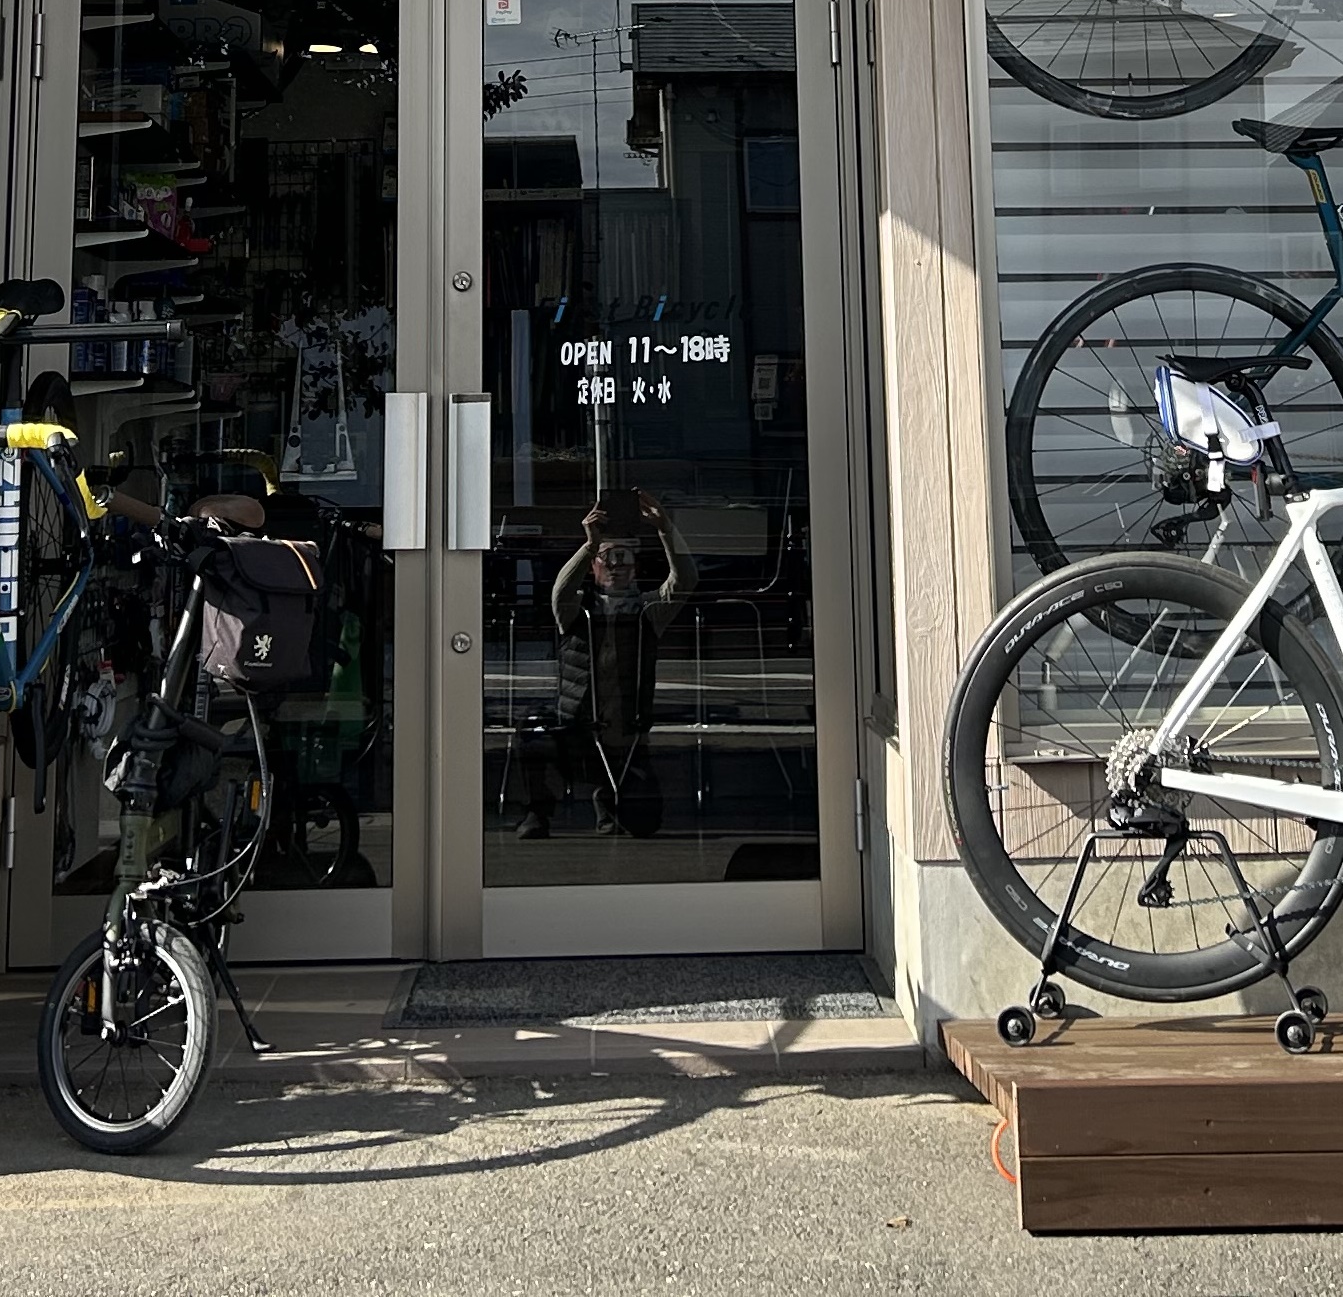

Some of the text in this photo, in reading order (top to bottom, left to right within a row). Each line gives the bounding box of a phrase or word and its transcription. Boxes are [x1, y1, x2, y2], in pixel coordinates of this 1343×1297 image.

[560, 340, 612, 366] OPEN
[577, 376, 616, 405] 定休日
[1004, 589, 1085, 654] DURA-ACE
